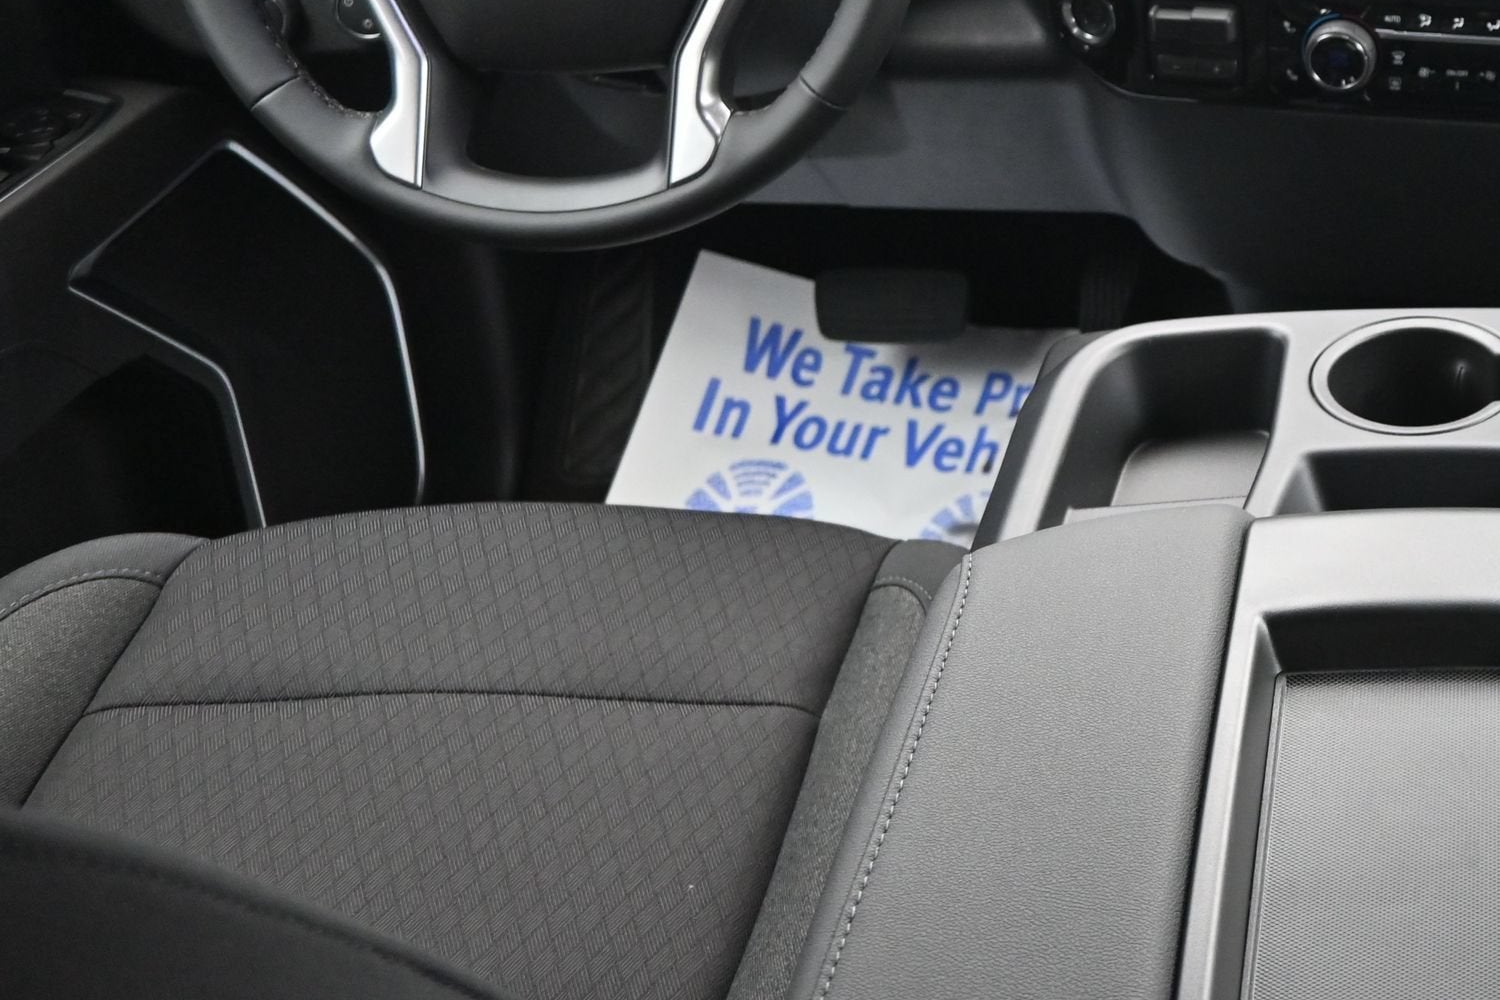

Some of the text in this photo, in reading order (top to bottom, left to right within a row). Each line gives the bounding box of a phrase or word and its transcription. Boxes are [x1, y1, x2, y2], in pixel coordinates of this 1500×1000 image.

[1383, 14, 1401, 23] AUTO
[742, 315, 825, 388] We
[839, 342, 962, 414] Take
[692, 377, 752, 441] In
[769, 394, 891, 463] Your
